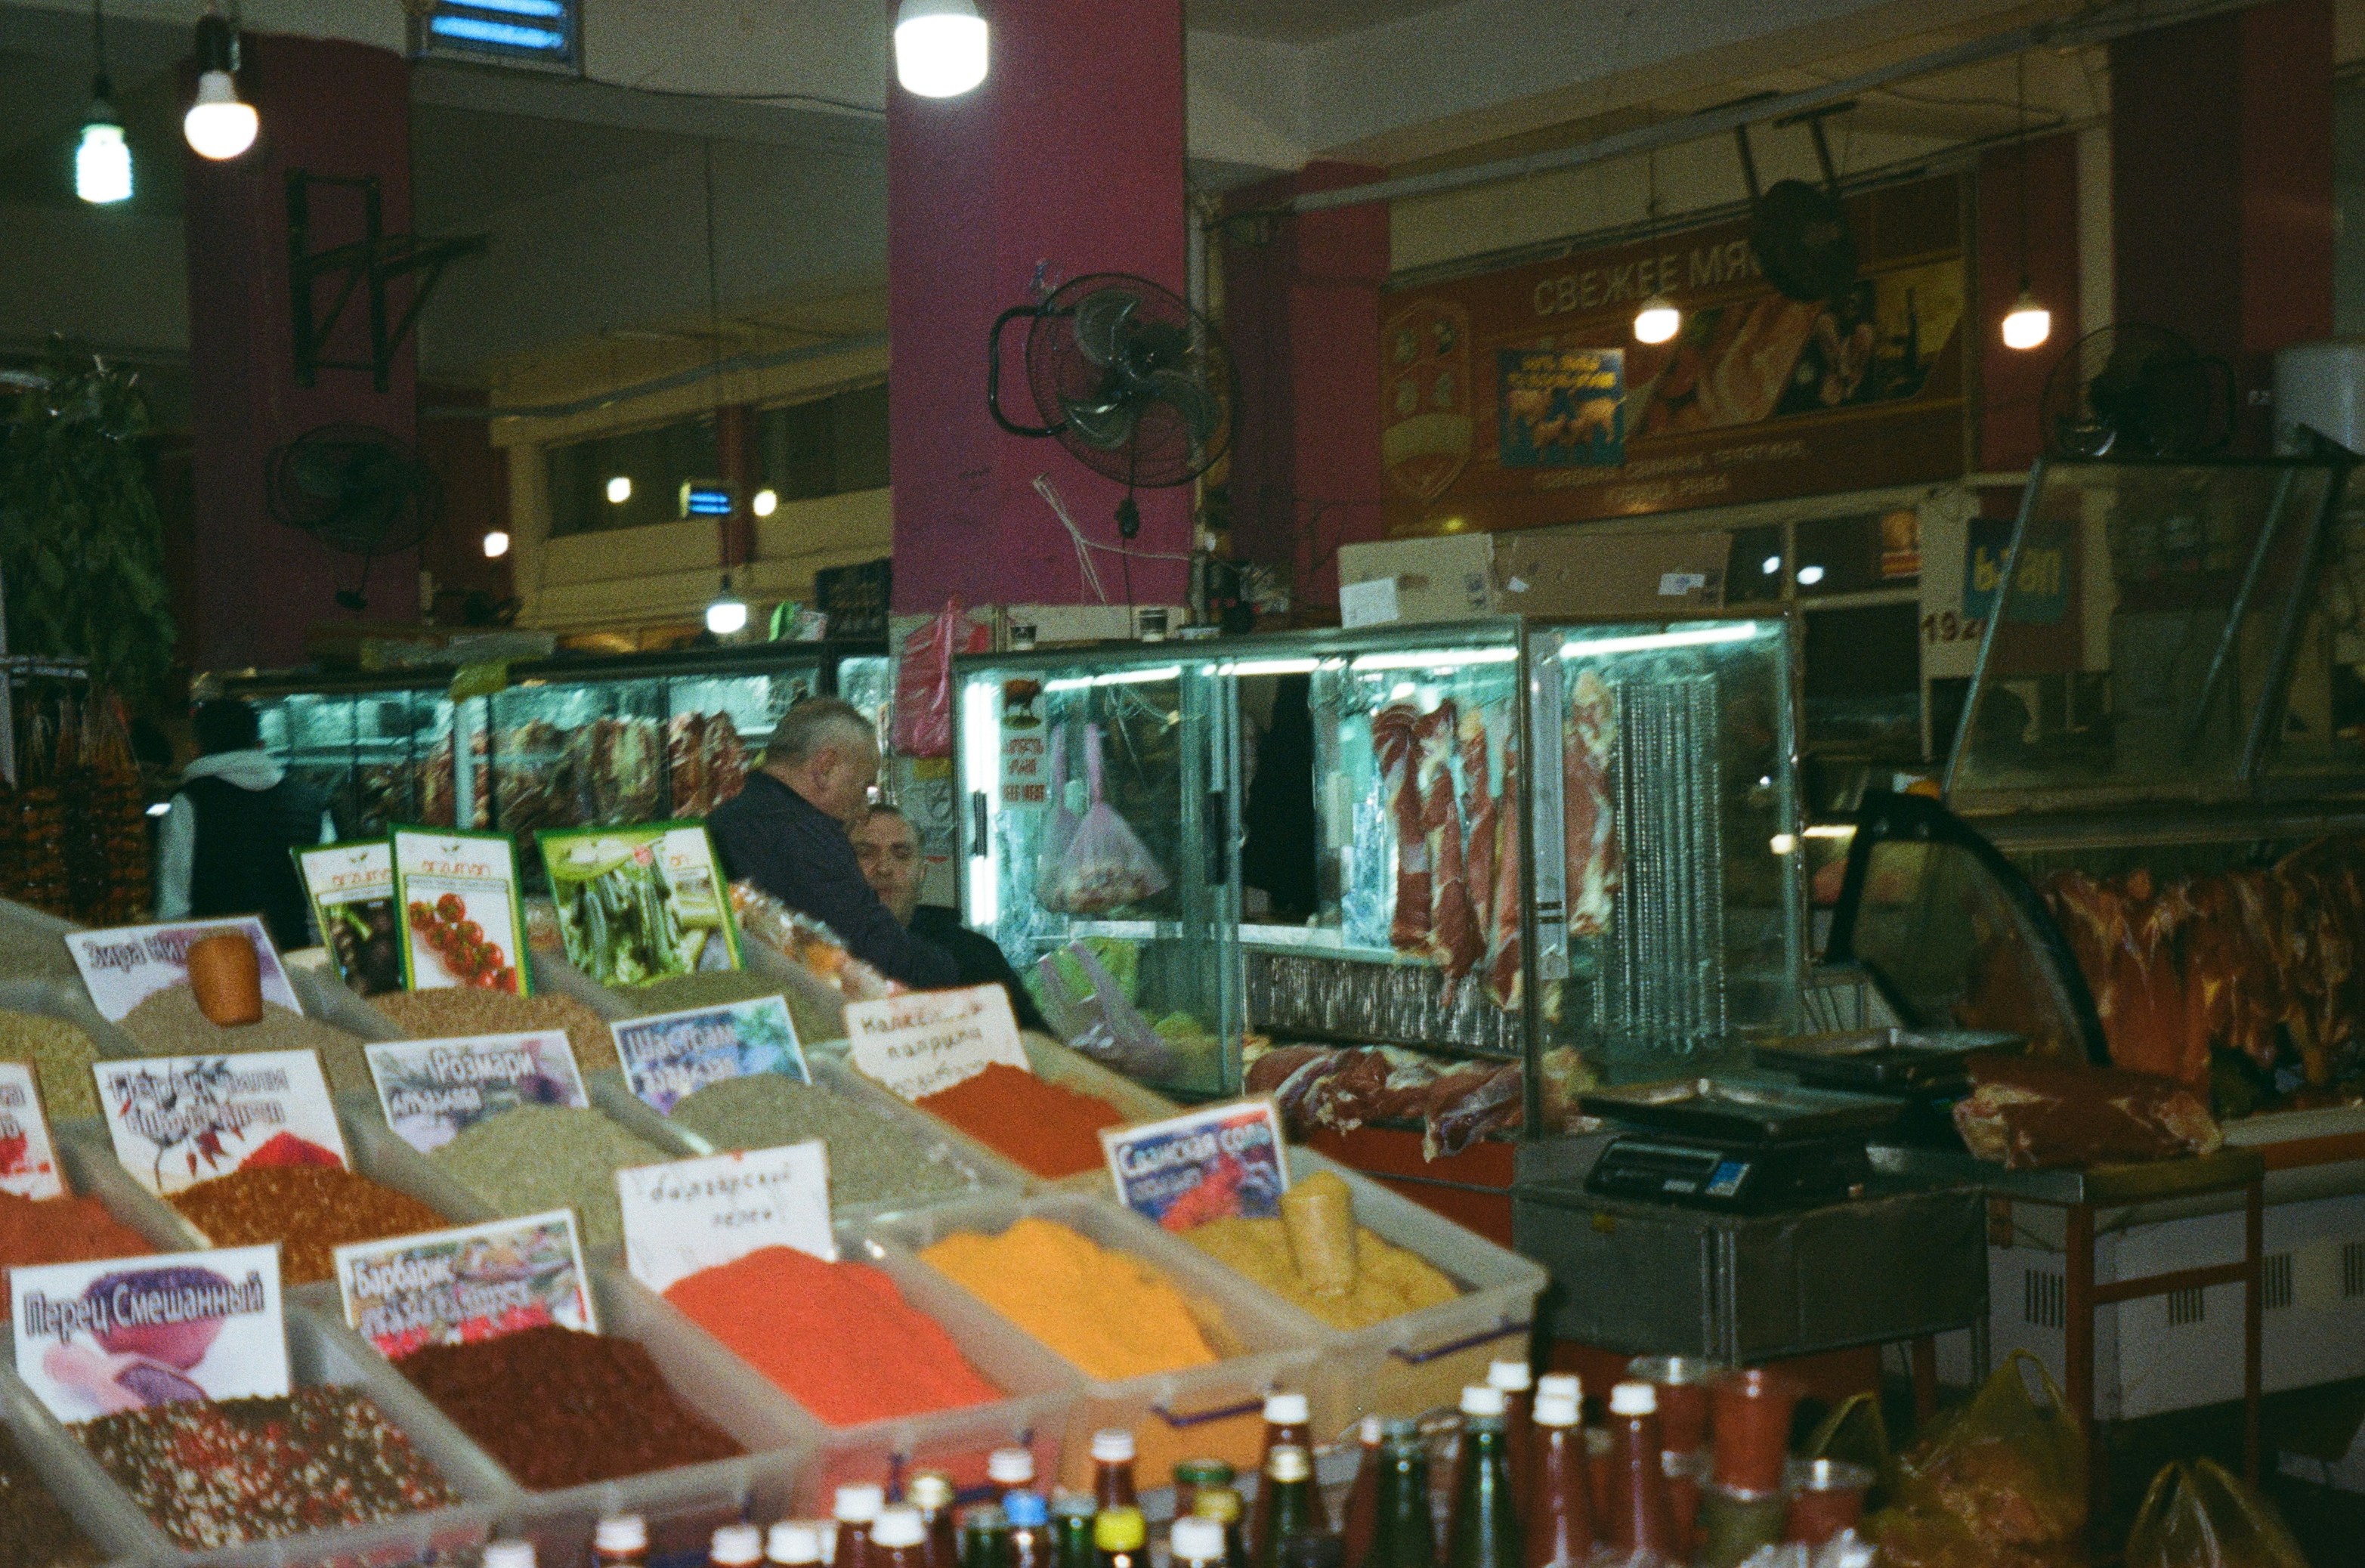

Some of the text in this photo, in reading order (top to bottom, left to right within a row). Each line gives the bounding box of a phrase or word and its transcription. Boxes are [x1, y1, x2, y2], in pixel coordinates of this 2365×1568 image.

[1534, 254, 1679, 317] СВЕЖЕЕ
[354, 1252, 456, 1300] Барбарис
[23, 1273, 266, 1348] Перец Смешанный
